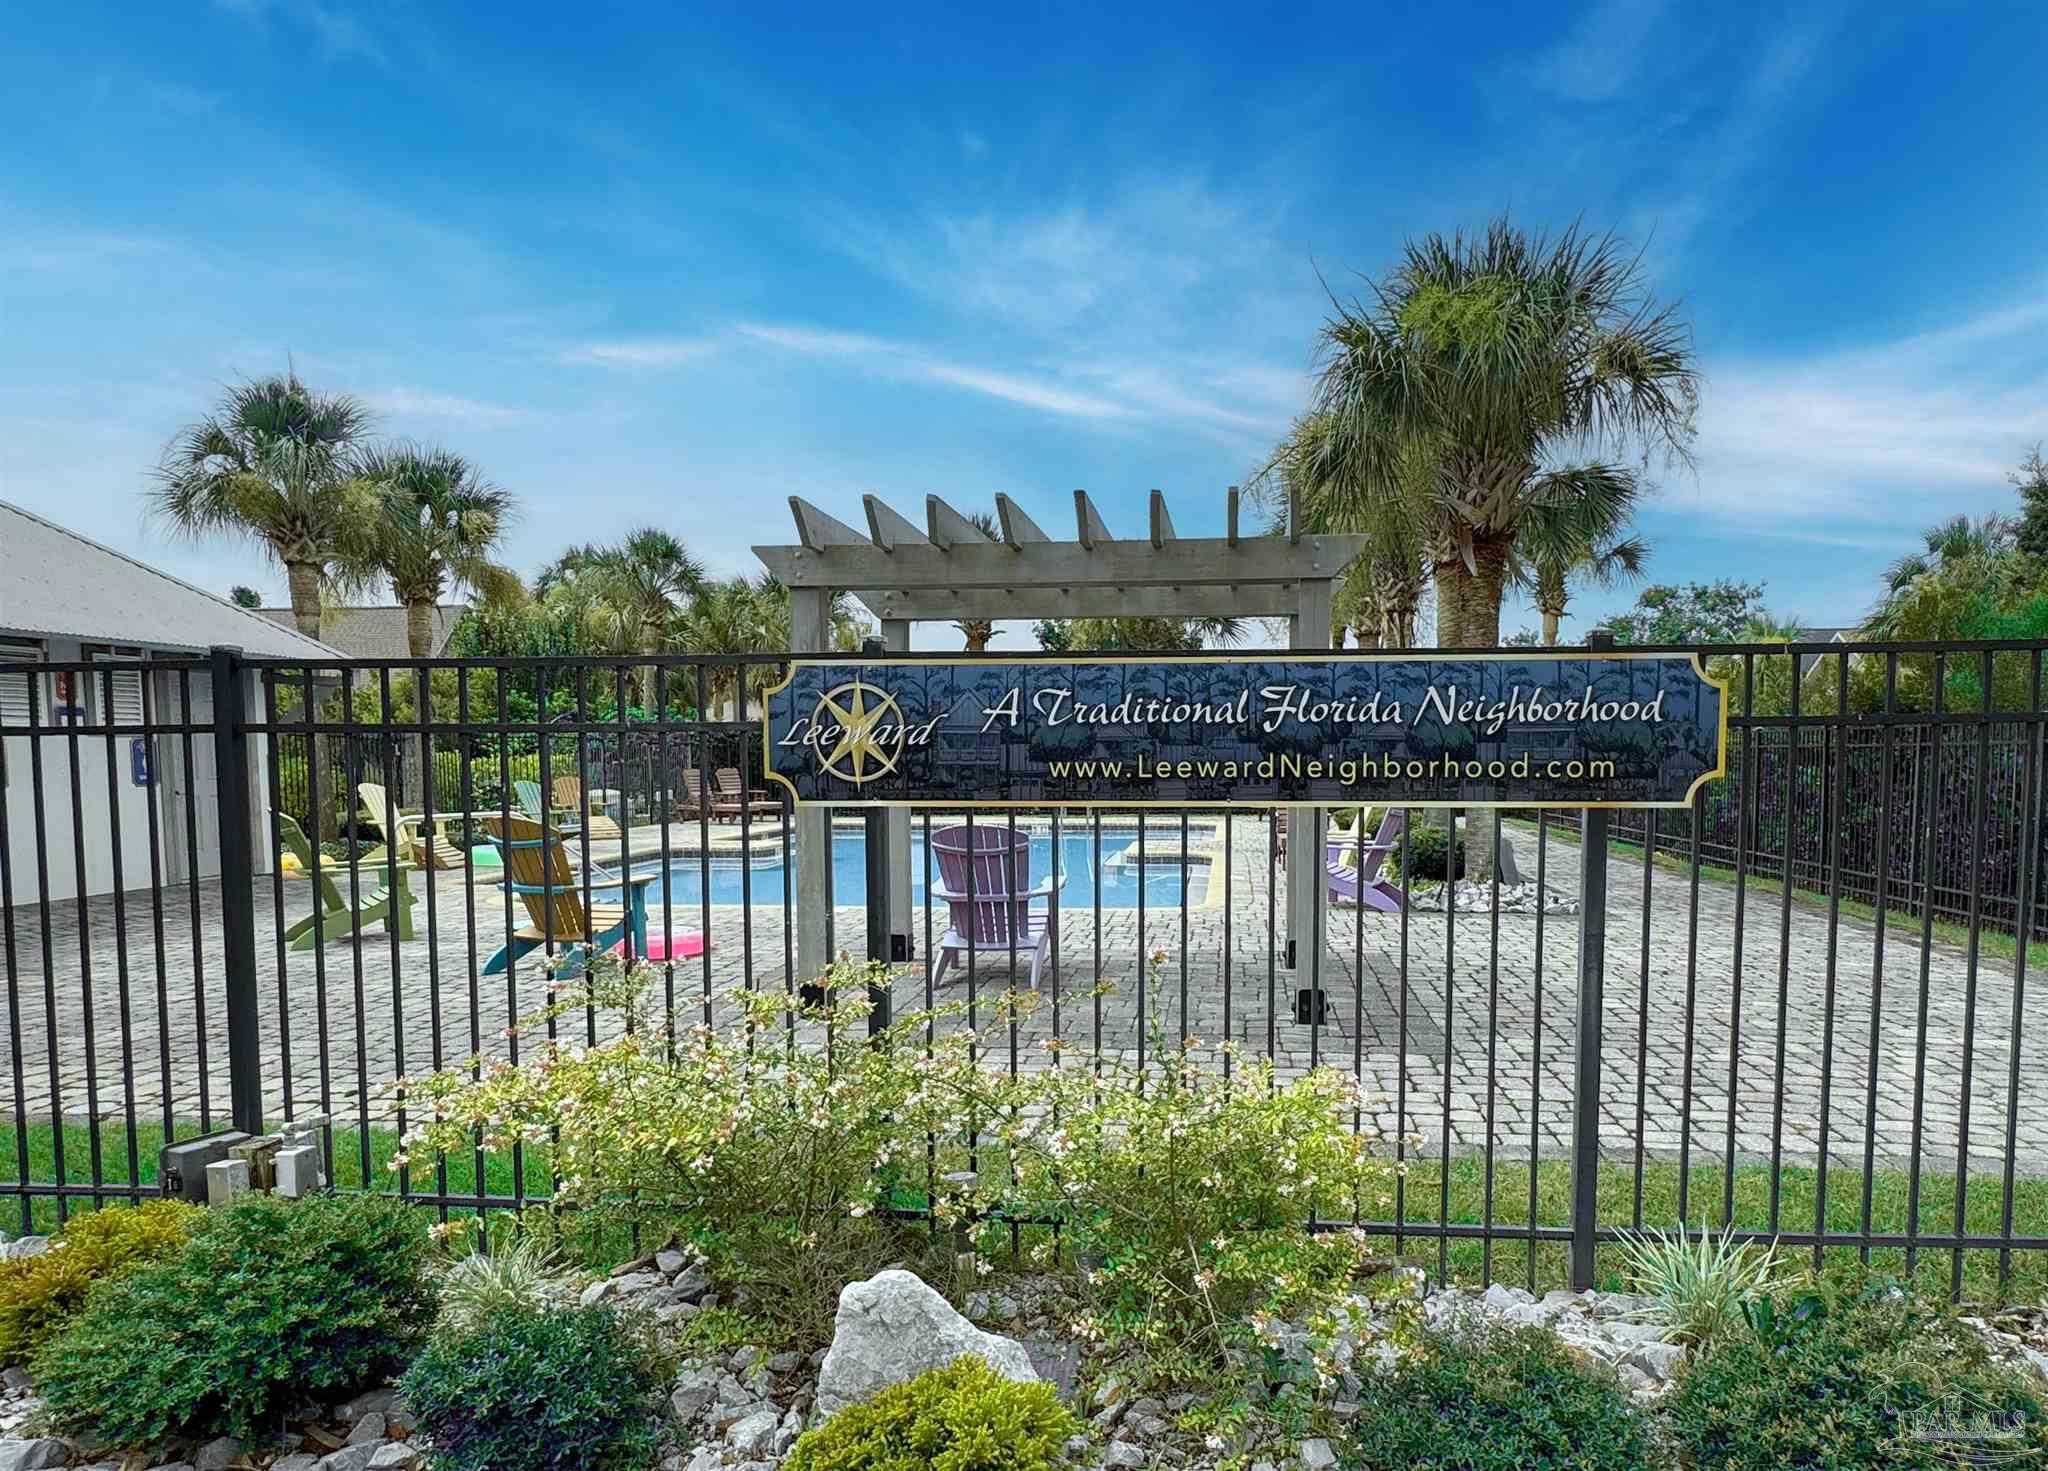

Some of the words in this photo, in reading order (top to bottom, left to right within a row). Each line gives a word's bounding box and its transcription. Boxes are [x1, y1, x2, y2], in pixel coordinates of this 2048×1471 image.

[981, 687, 1019, 733] A
[1033, 687, 1250, 726] Traditional
[1261, 685, 1403, 733] Florida
[1413, 685, 1664, 734] Neighborhood
[777, 713, 950, 747] Leeward
[1048, 753, 1617, 785] www.LeewardNeighborhood.com
